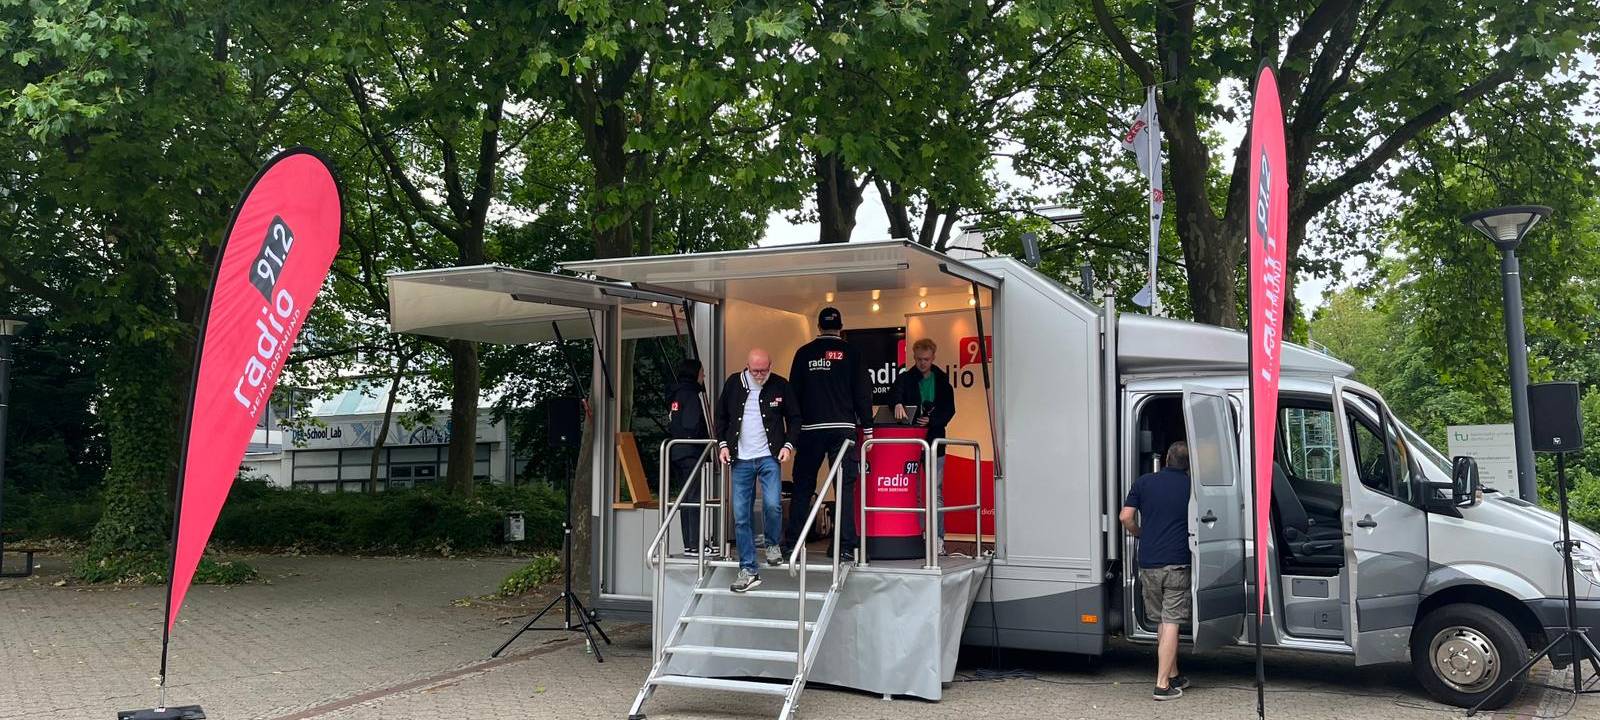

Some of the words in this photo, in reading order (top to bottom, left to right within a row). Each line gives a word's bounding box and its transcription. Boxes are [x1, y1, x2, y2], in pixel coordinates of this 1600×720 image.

[257, 223, 294, 286] 91.2
[233, 288, 294, 409] radio
[250, 382, 267, 418] MEIN
[267, 309, 300, 379] DORTMUND
[808, 357, 832, 368] radio
[828, 351, 843, 360] 91.2
[877, 473, 909, 487] radio
